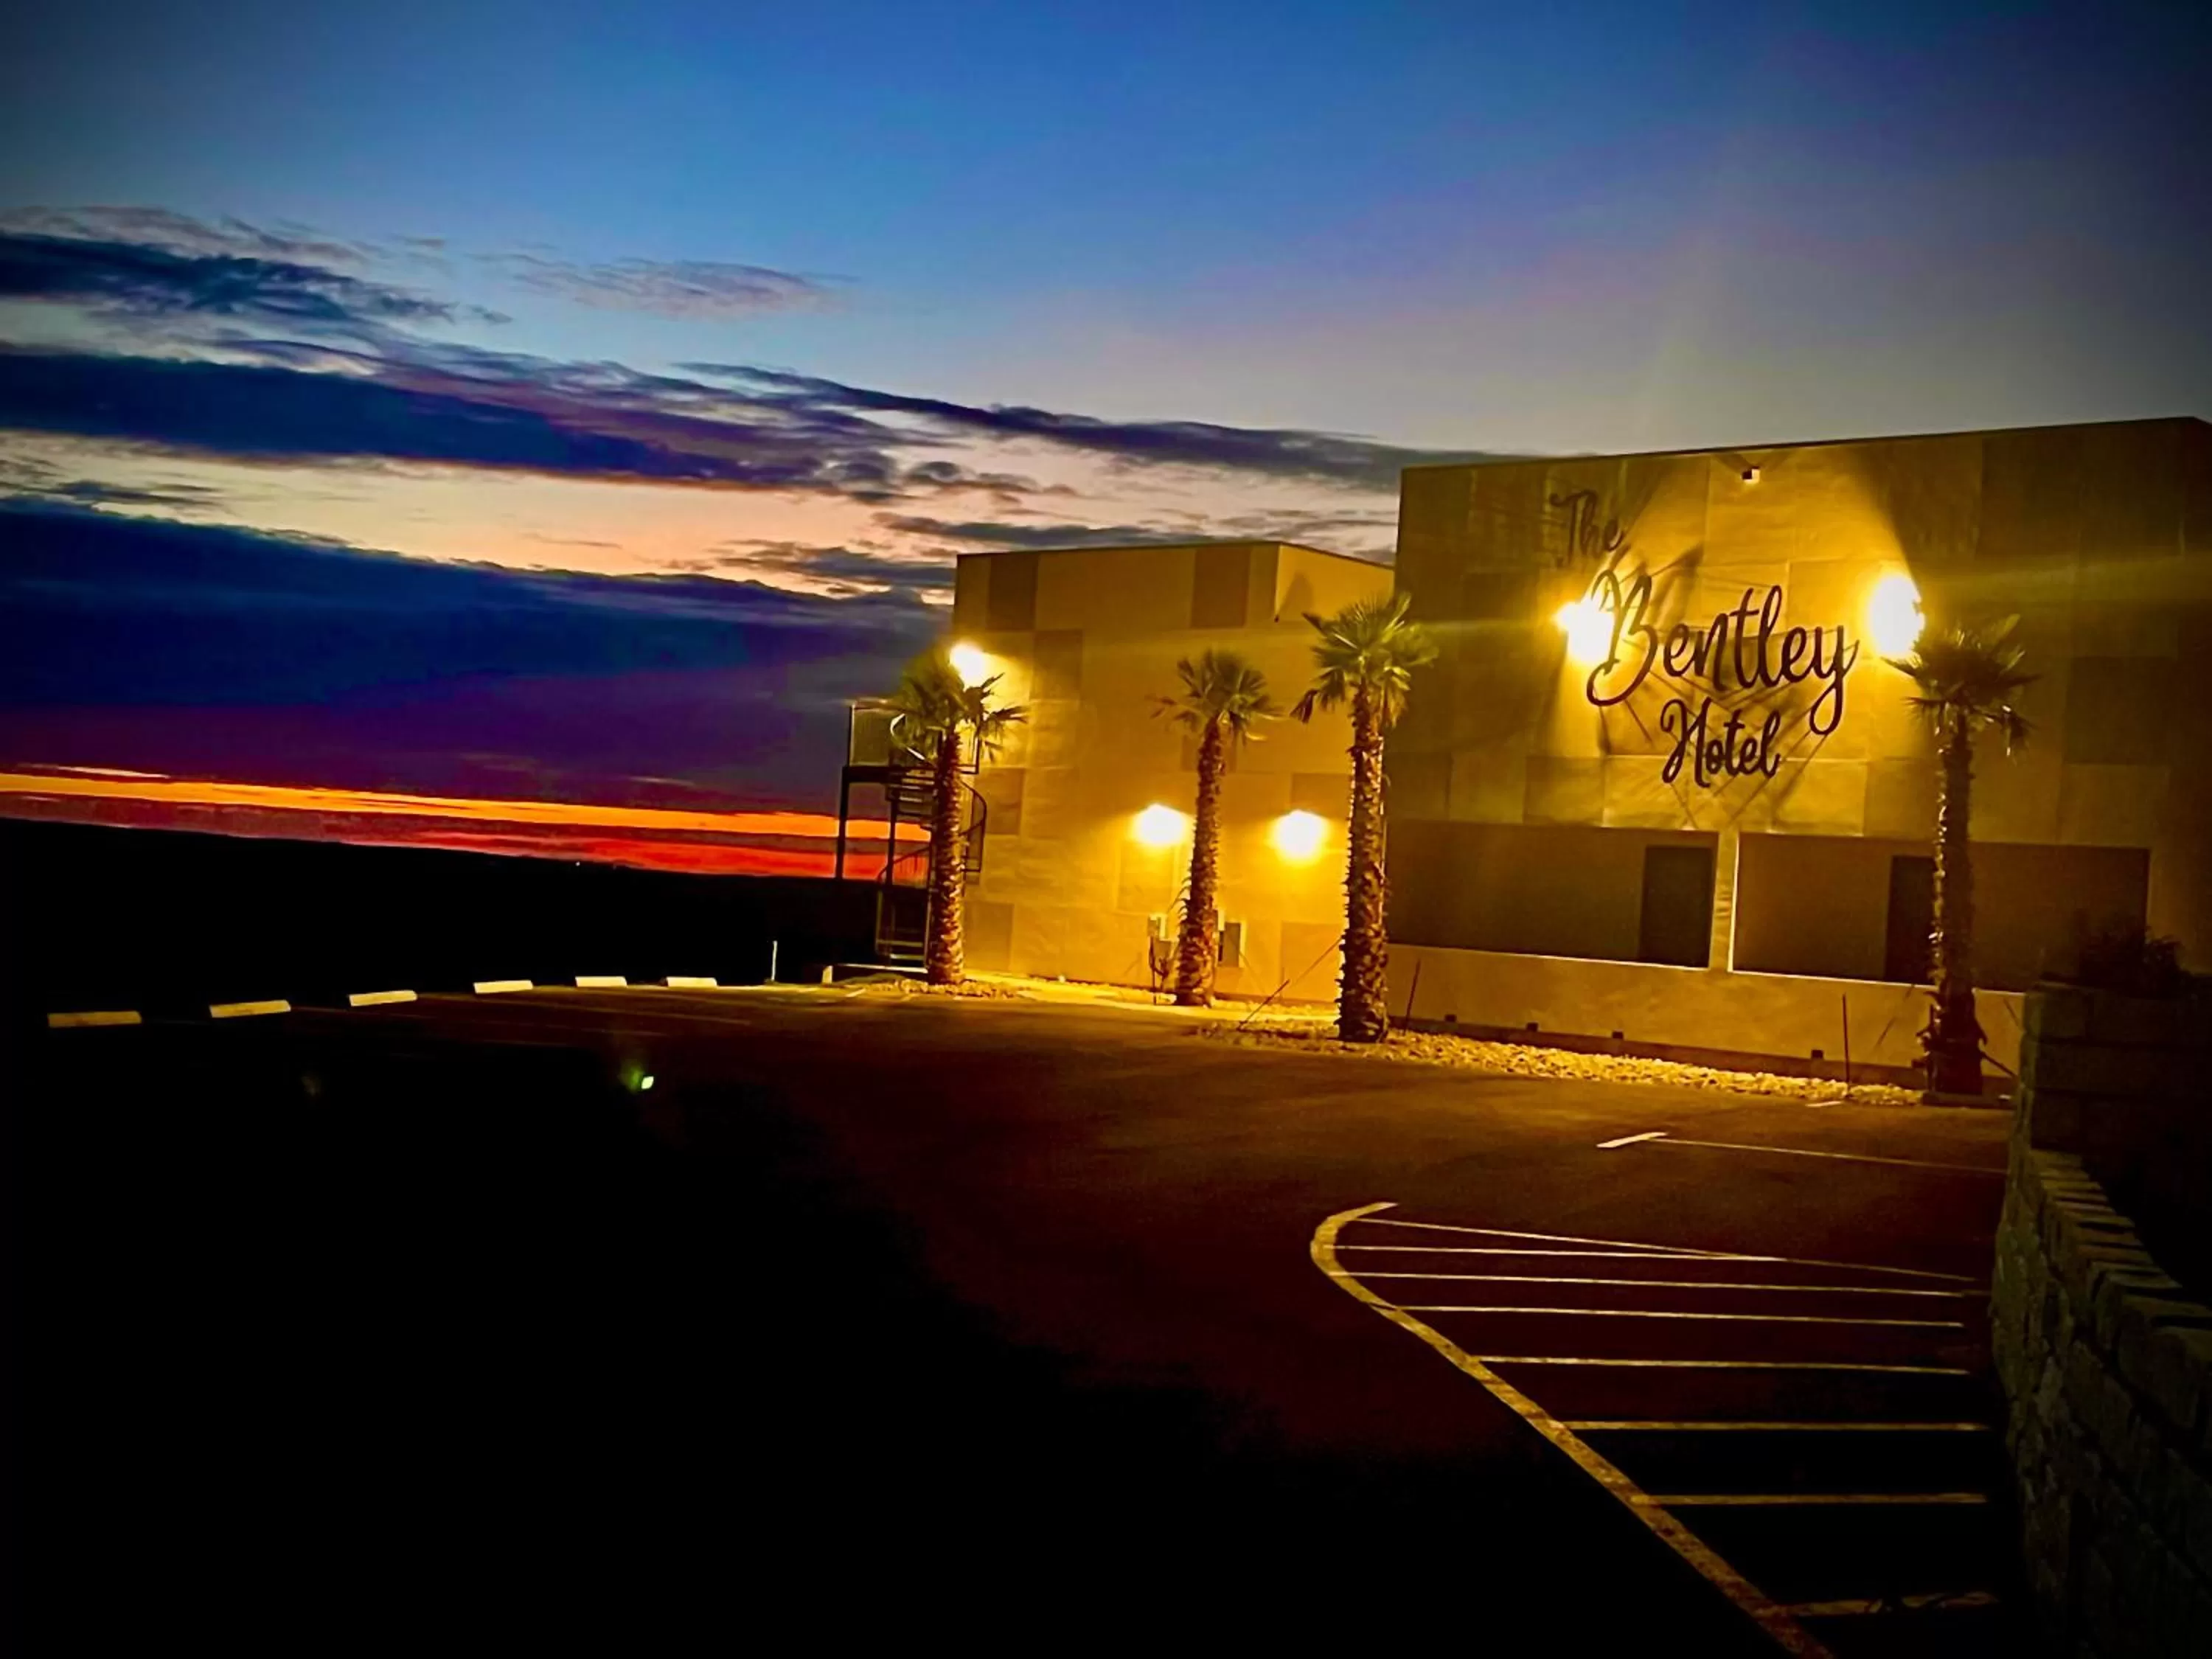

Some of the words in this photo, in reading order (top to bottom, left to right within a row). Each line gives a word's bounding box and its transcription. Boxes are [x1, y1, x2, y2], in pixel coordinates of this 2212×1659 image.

[1549, 490, 1623, 566] The
[1586, 569, 1859, 735] Bentley
[1660, 696, 1781, 787] Hotel
